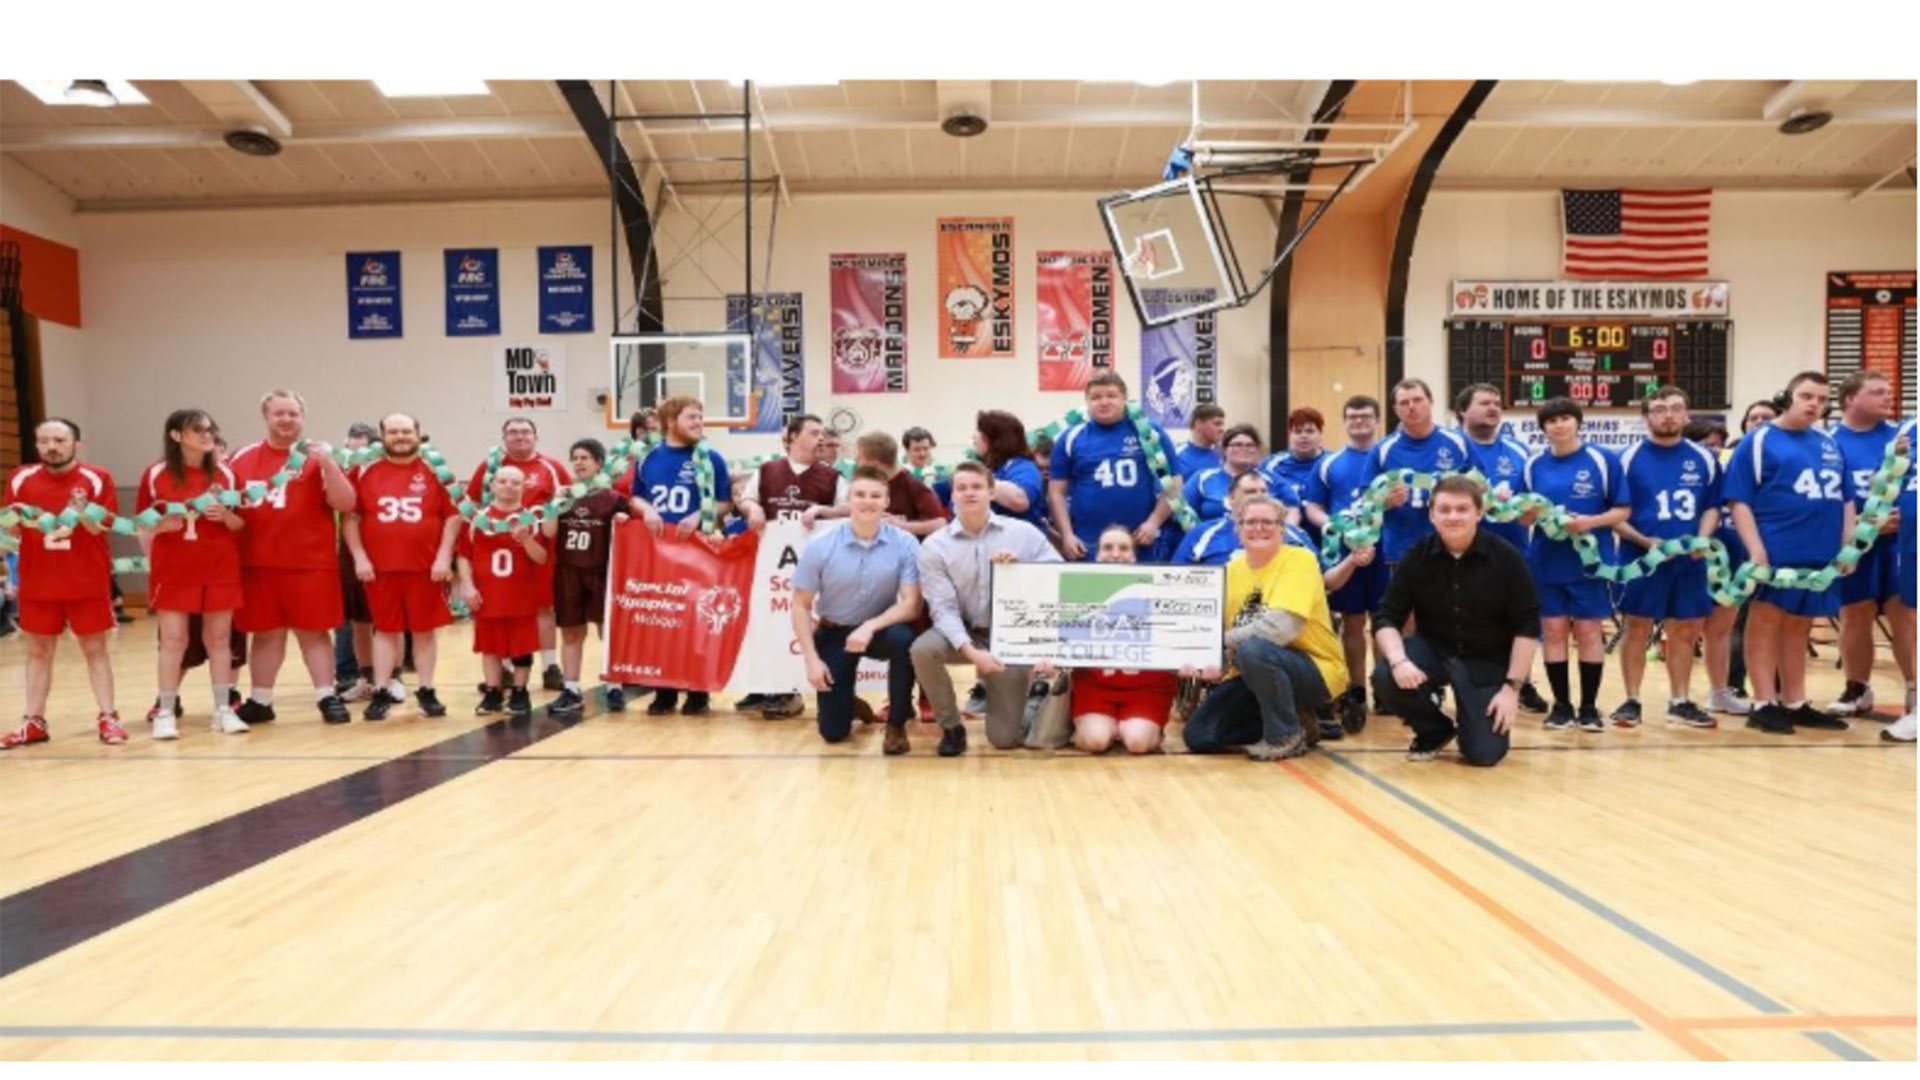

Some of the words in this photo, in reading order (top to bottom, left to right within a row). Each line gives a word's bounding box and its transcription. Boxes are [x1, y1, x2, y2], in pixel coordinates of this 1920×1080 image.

[992, 233, 1011, 352] ESKYMOS
[1493, 289, 1540, 309] HOME
[1546, 289, 1567, 309] OF
[1572, 289, 1605, 309] THE
[1607, 289, 1687, 309] ESKYMOS
[884, 269, 903, 392] MAROONS
[1091, 266, 1111, 369] REDMEN
[1530, 338, 1546, 361] 0
[1568, 325, 1625, 348] 6:00
[1652, 338, 1668, 361] 0
[507, 370, 557, 395] Town
[1531, 382, 1545, 400] 0
[1570, 383, 1594, 400] 00
[1597, 383, 1610, 400] 0
[1093, 458, 1139, 488] 40
[1793, 469, 1844, 501] 42
[1852, 469, 1875, 500] 5
[376, 496, 423, 523] 35
[650, 485, 690, 514] 20
[1655, 489, 1696, 521] 13
[565, 531, 590, 551] 20
[490, 547, 514, 578] 0
[615, 595, 686, 611] lympics
[1058, 643, 1152, 662] COLLEGE
